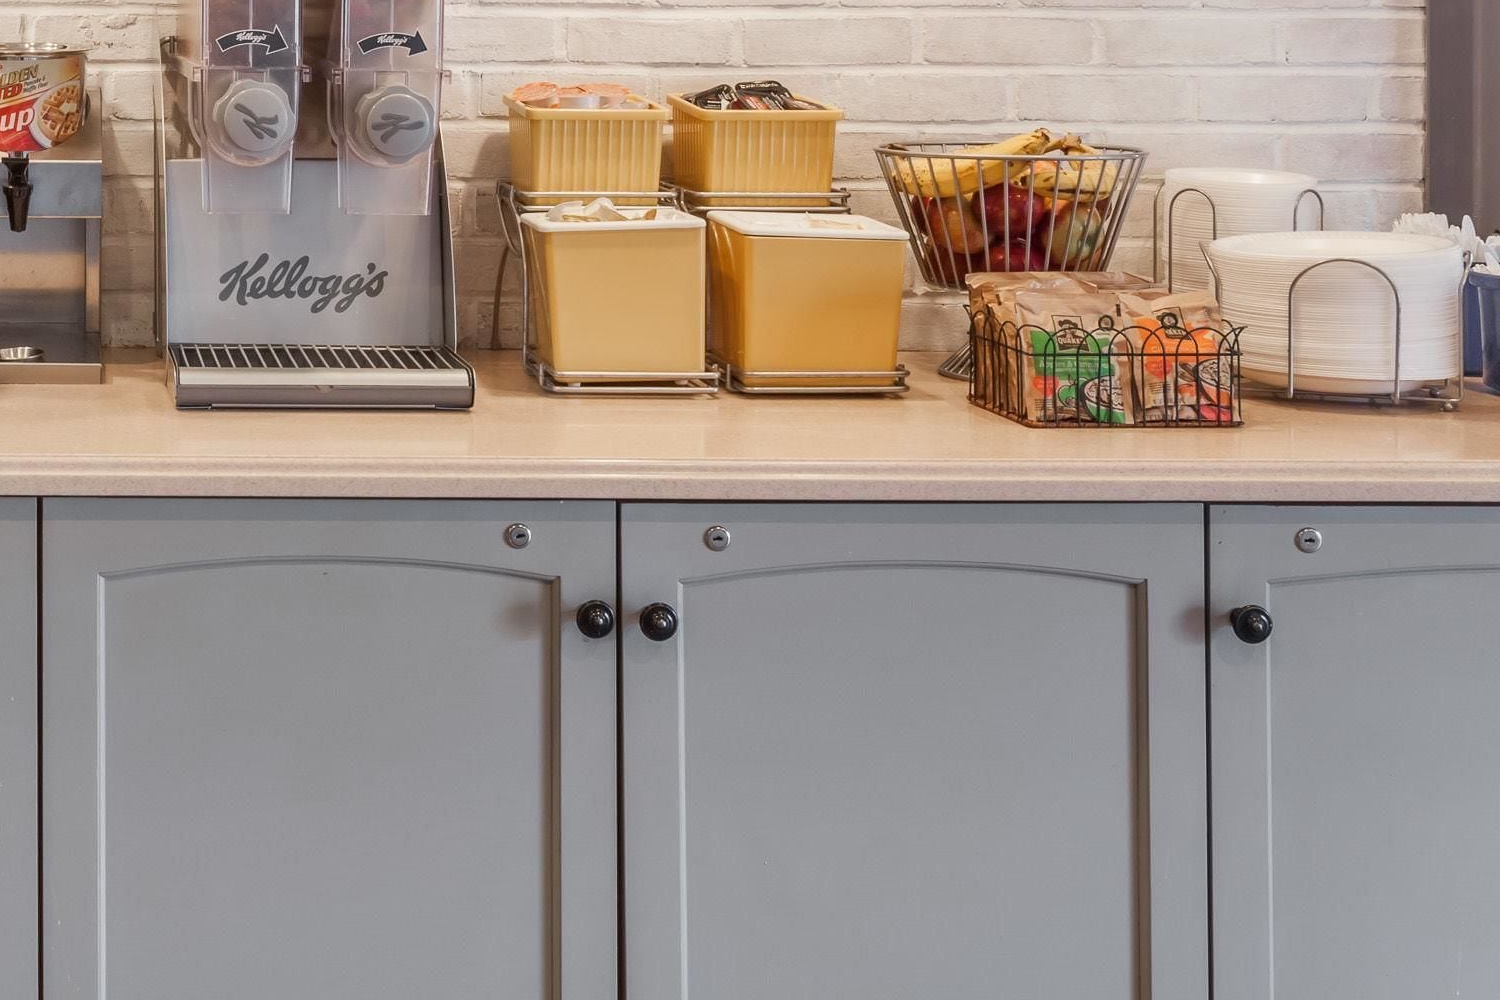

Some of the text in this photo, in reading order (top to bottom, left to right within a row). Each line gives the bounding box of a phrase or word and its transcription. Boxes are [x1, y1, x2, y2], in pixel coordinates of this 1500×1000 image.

[235, 31, 268, 42] Kellogg's
[376, 34, 409, 46] Kellogg's
[219, 252, 389, 314] Kellogg's
